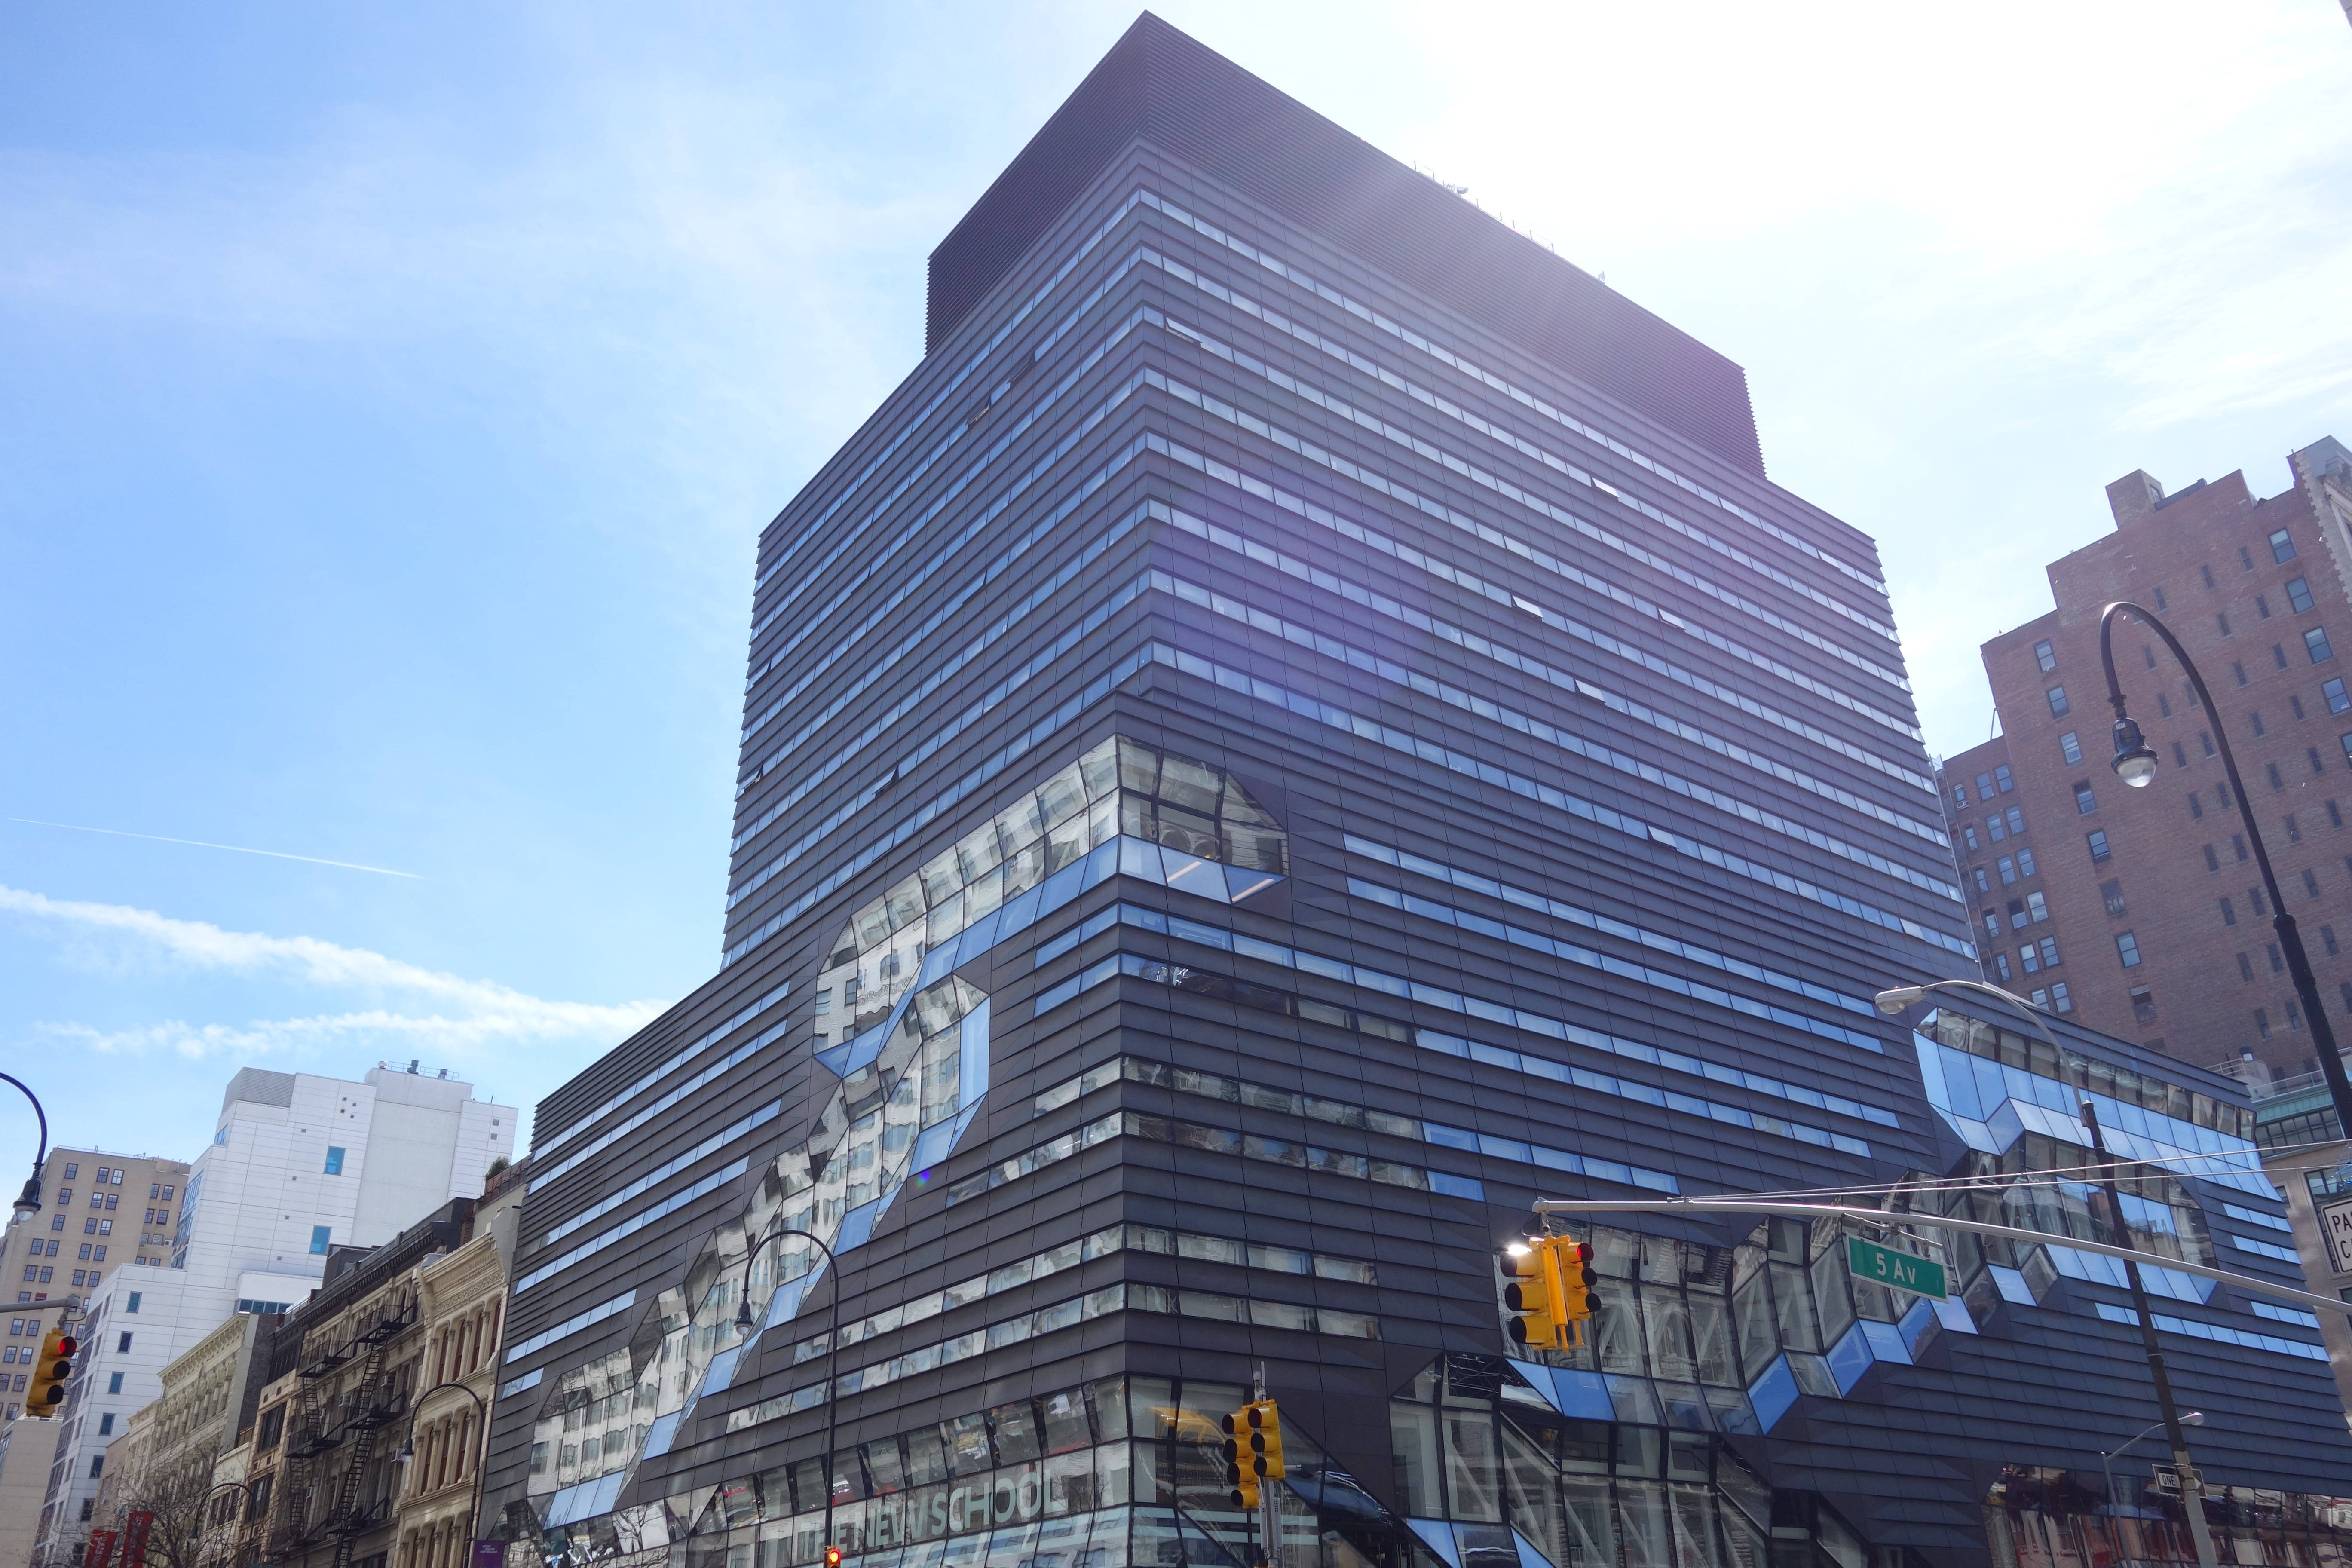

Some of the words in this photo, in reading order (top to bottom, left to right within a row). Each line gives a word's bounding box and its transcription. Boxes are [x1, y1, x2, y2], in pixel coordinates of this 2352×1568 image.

[2331, 1210, 2352, 1233] PA
[2340, 1238, 2352, 1258] C
[1876, 1252, 1886, 1276] 5
[2162, 1475, 2176, 1486] ONE
[800, 1513, 849, 1559] THE
[853, 1495, 928, 1550] NEW
[931, 1469, 1069, 1536] SCHOOL
